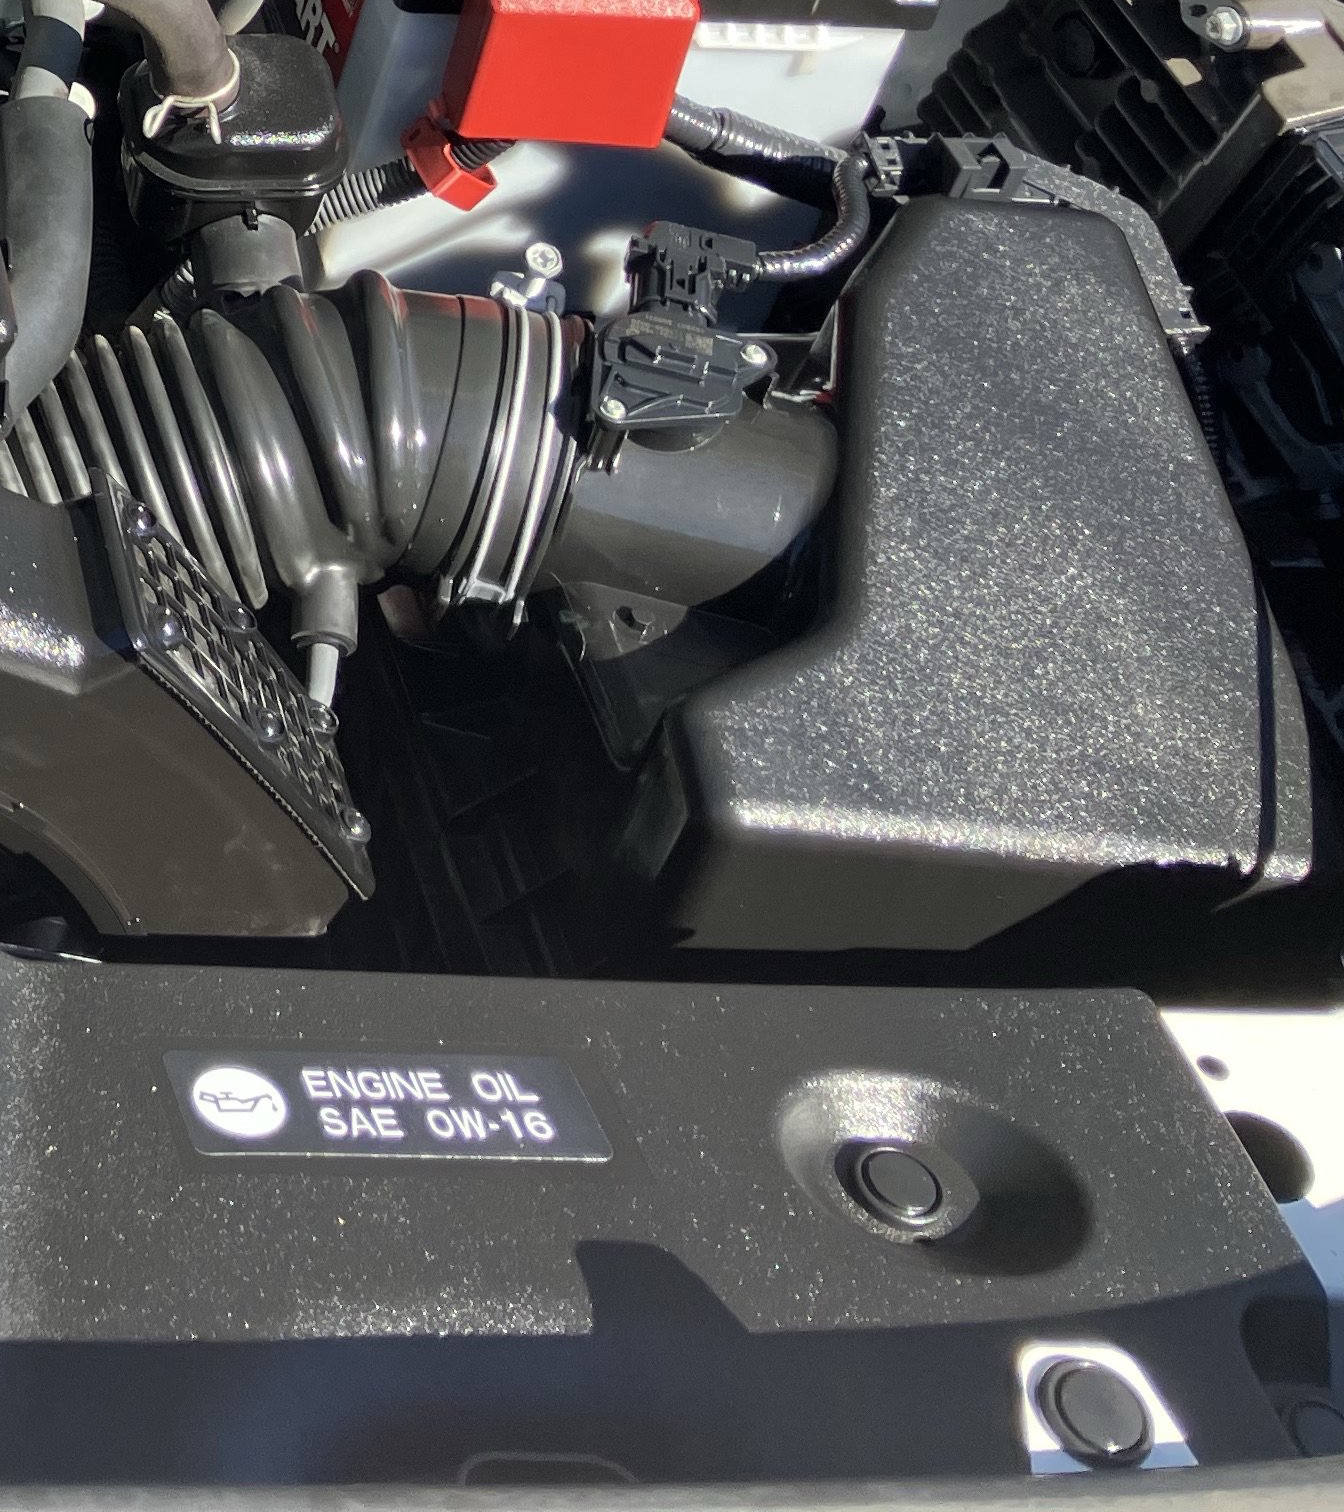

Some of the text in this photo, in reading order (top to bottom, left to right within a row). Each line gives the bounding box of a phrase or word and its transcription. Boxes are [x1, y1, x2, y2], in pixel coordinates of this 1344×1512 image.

[301, 1067, 540, 1103] ENGINE OIL
[319, 1105, 405, 1138] SAE
